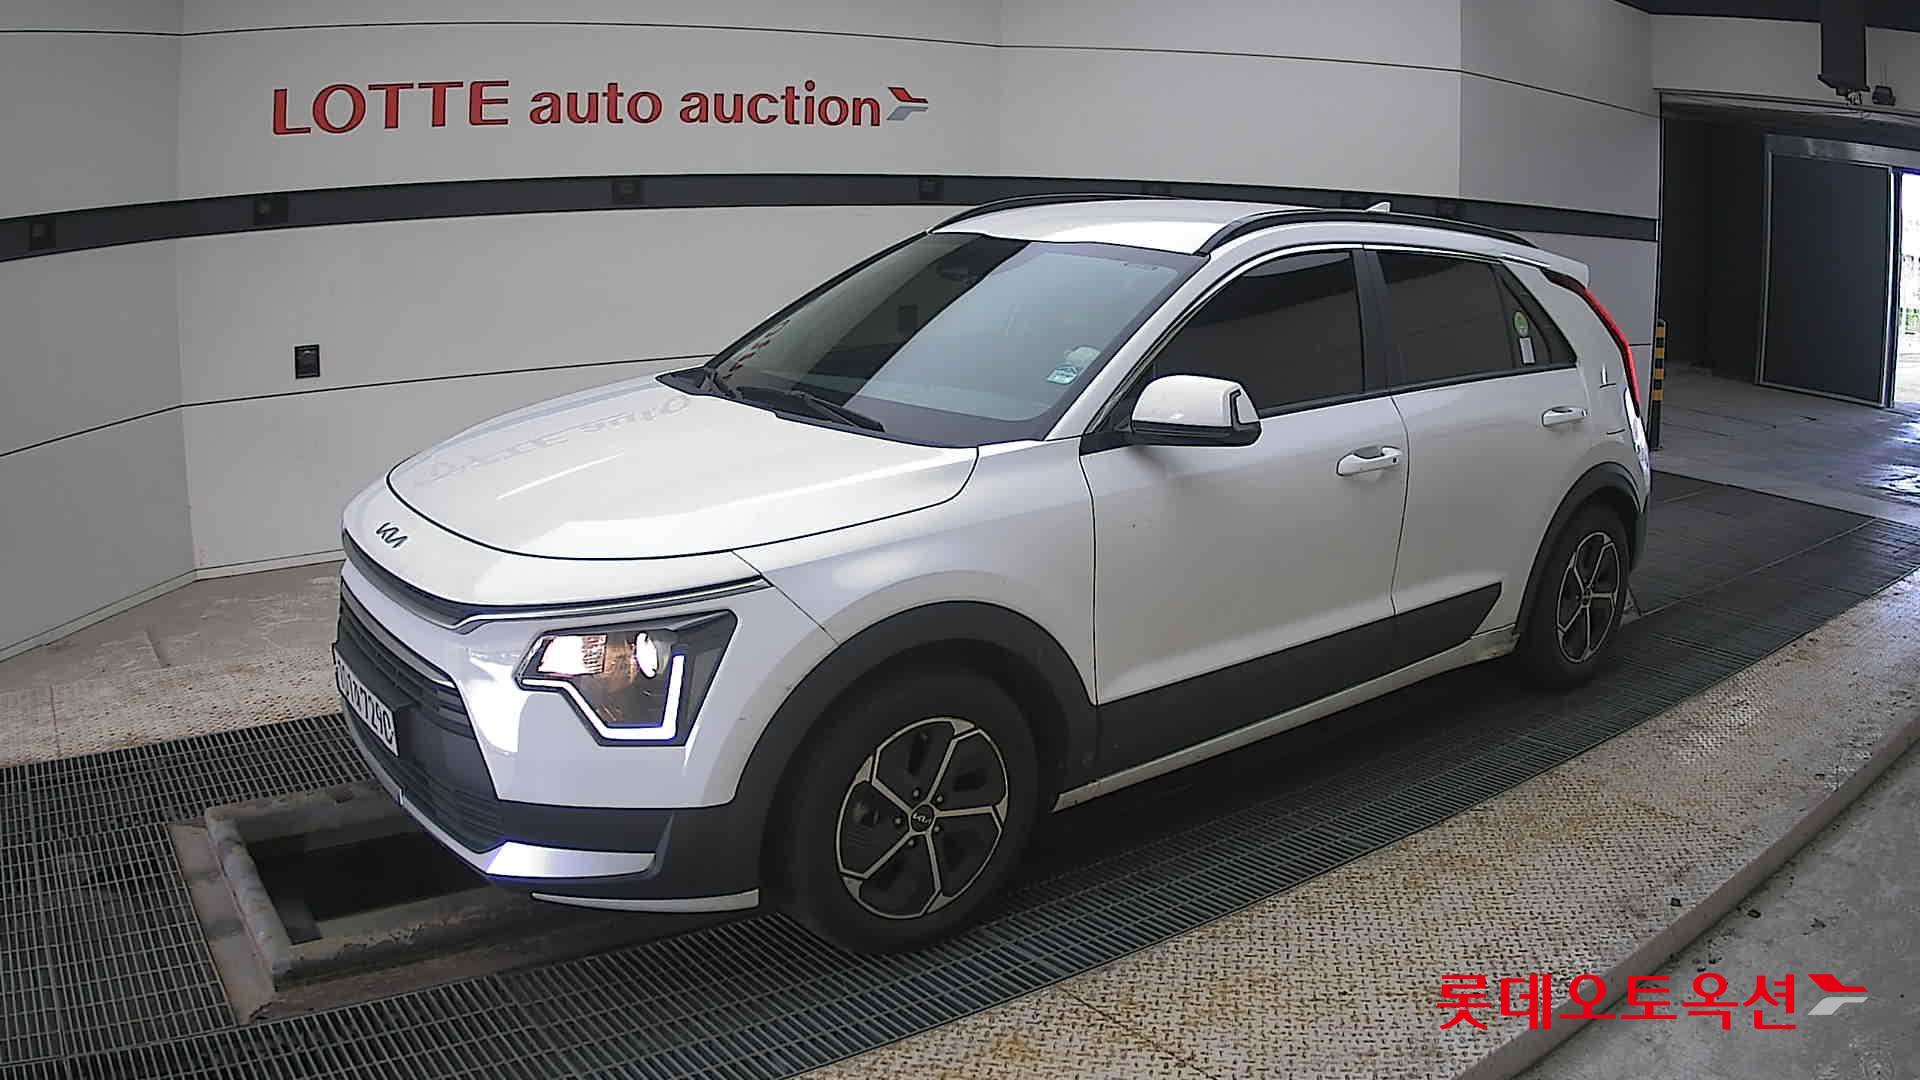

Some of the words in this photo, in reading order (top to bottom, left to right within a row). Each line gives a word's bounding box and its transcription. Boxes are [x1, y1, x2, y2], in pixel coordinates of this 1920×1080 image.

[274, 82, 509, 135] LOTTE
[530, 84, 662, 124] auto
[682, 83, 881, 124] auction
